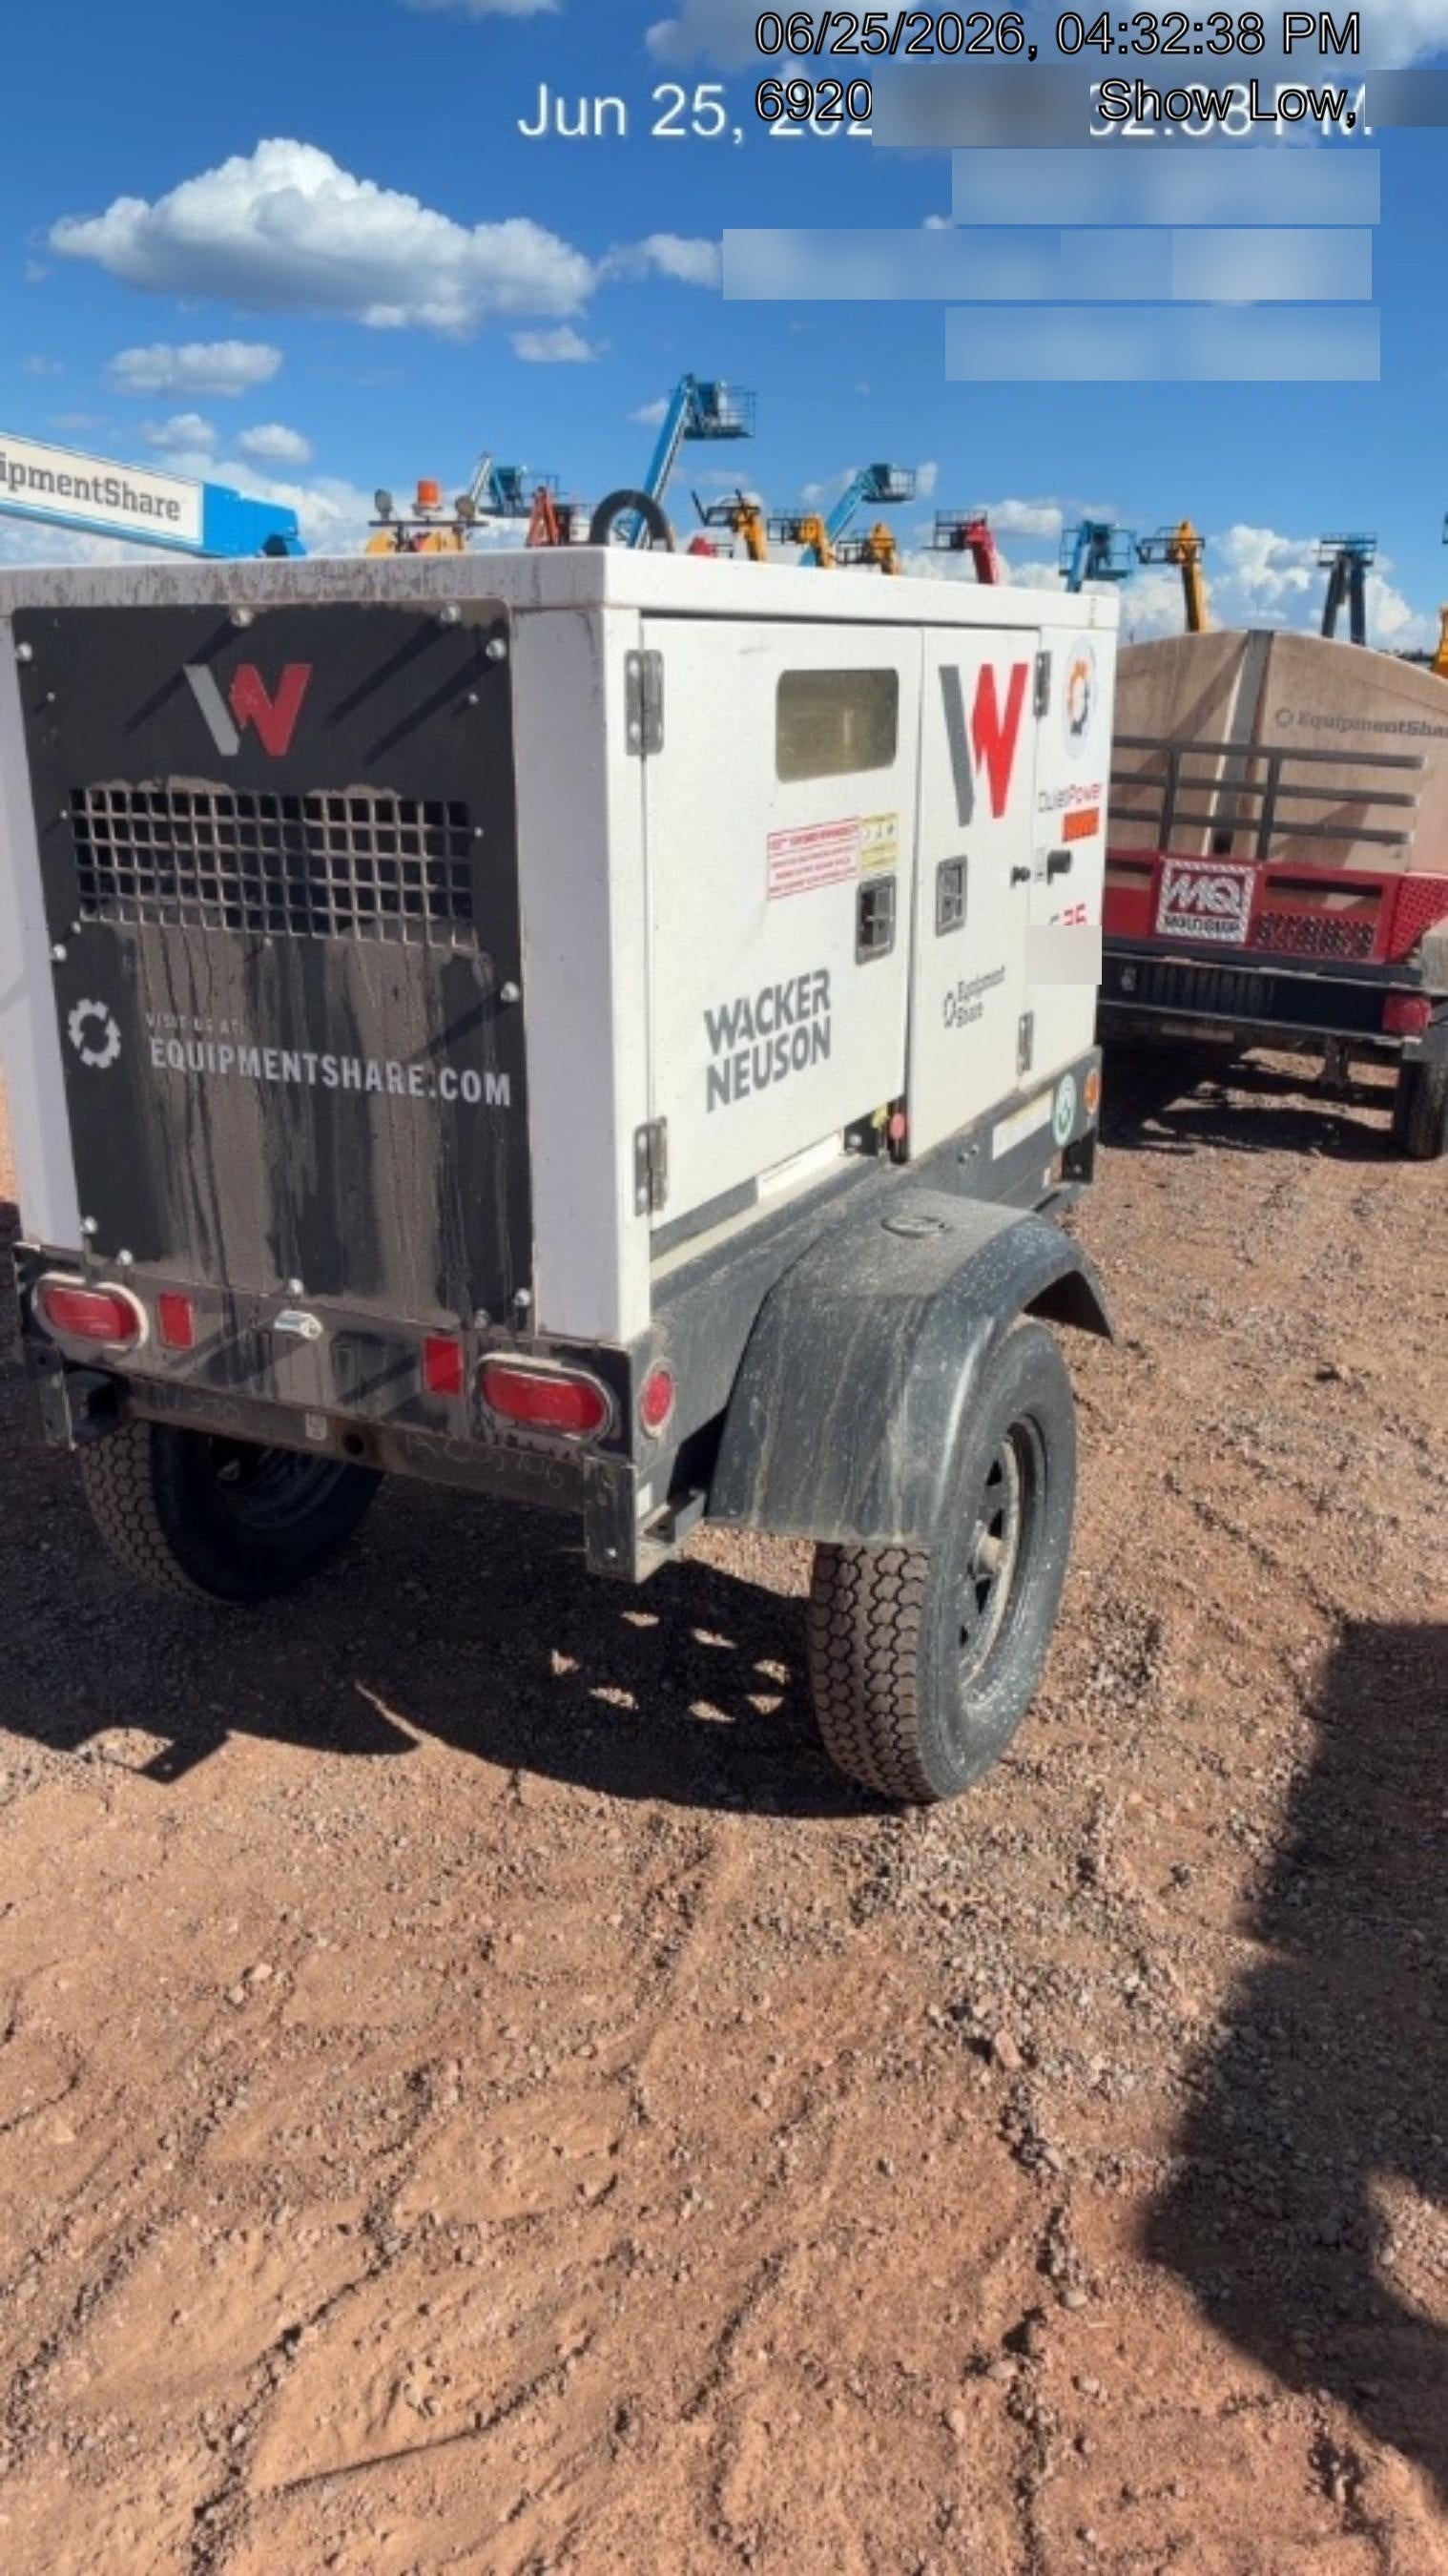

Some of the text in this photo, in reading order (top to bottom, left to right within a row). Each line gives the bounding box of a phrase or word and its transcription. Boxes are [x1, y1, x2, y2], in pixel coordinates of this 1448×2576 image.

[703, 967, 831, 1055] WACKER
[150, 1037, 510, 1107] EQUIPMENTSHARE.COM
[706, 1015, 831, 1114] NEUSON
